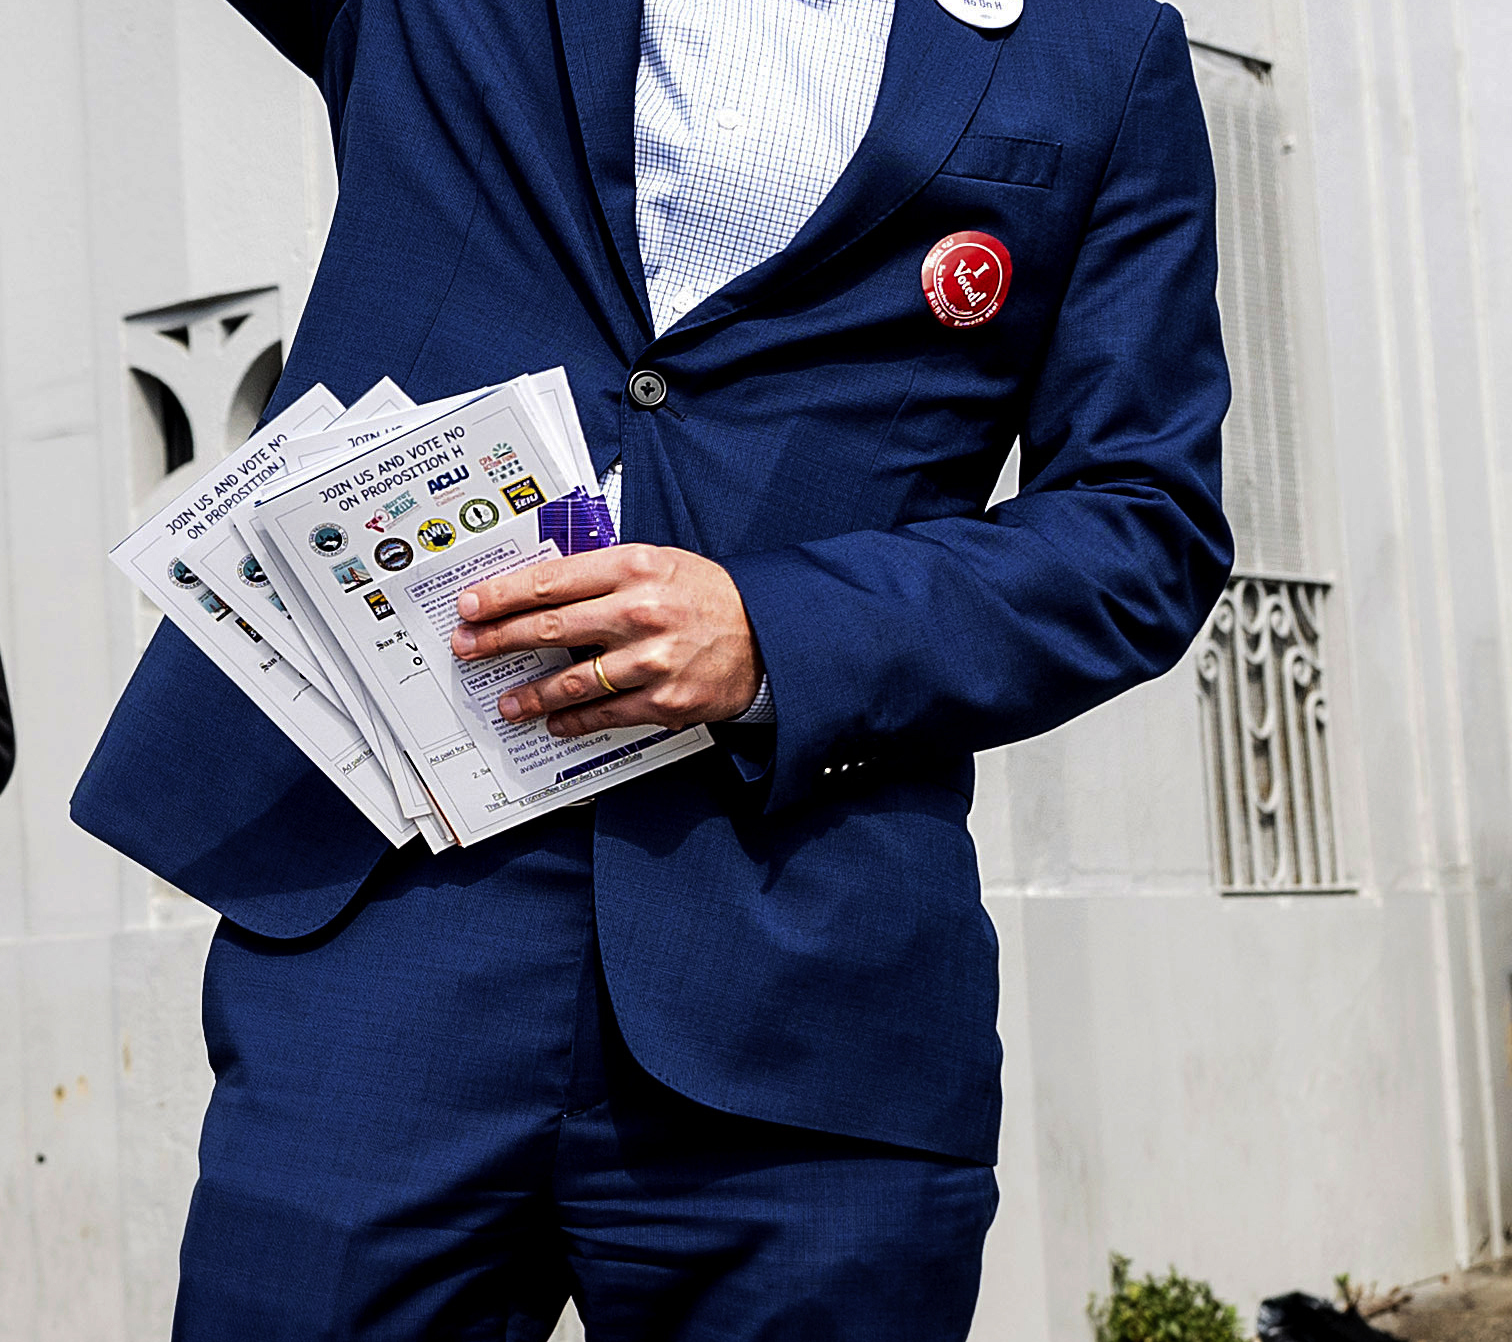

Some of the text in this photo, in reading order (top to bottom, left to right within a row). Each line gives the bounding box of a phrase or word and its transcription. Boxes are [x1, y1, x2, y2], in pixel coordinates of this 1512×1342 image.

[995, 1, 1002, 10] H
[954, 259, 987, 307] Voted!
[973, 262, 990, 278] I
[318, 425, 466, 503] JOIN US AND VOTE NO
[338, 444, 465, 512] ON PROPOSITION H
[427, 464, 470, 495] ACLU
[165, 507, 196, 536] JOIN
[193, 493, 214, 512] US
[214, 474, 239, 499] AND
[237, 447, 270, 476] VOTE
[187, 462, 280, 540] ON PROPOSITION
[389, 495, 418, 519] Milk
[513, 493, 539, 509] SEIU
[411, 581, 434, 594] MEET
[436, 572, 453, 583] THE
[468, 547, 504, 569] LEAGUE
[427, 574, 460, 593] PISSED
[460, 566, 478, 578] OFF
[480, 549, 516, 568] VOTERS
[467, 670, 492, 685] HANG
[492, 663, 512, 675] OUT
[512, 653, 535, 667] WITH
[470, 679, 489, 691] THE
[489, 664, 525, 683] LEAGUE
[429, 753, 439, 763] Ad
[439, 748, 454, 761] paid
[454, 745, 464, 754] for
[507, 733, 549, 755] Paid for by
[513, 751, 538, 765] Pissed
[539, 745, 553, 757] Off
[519, 733, 612, 774] available at sfethics.org
[525, 788, 559, 805] committee
